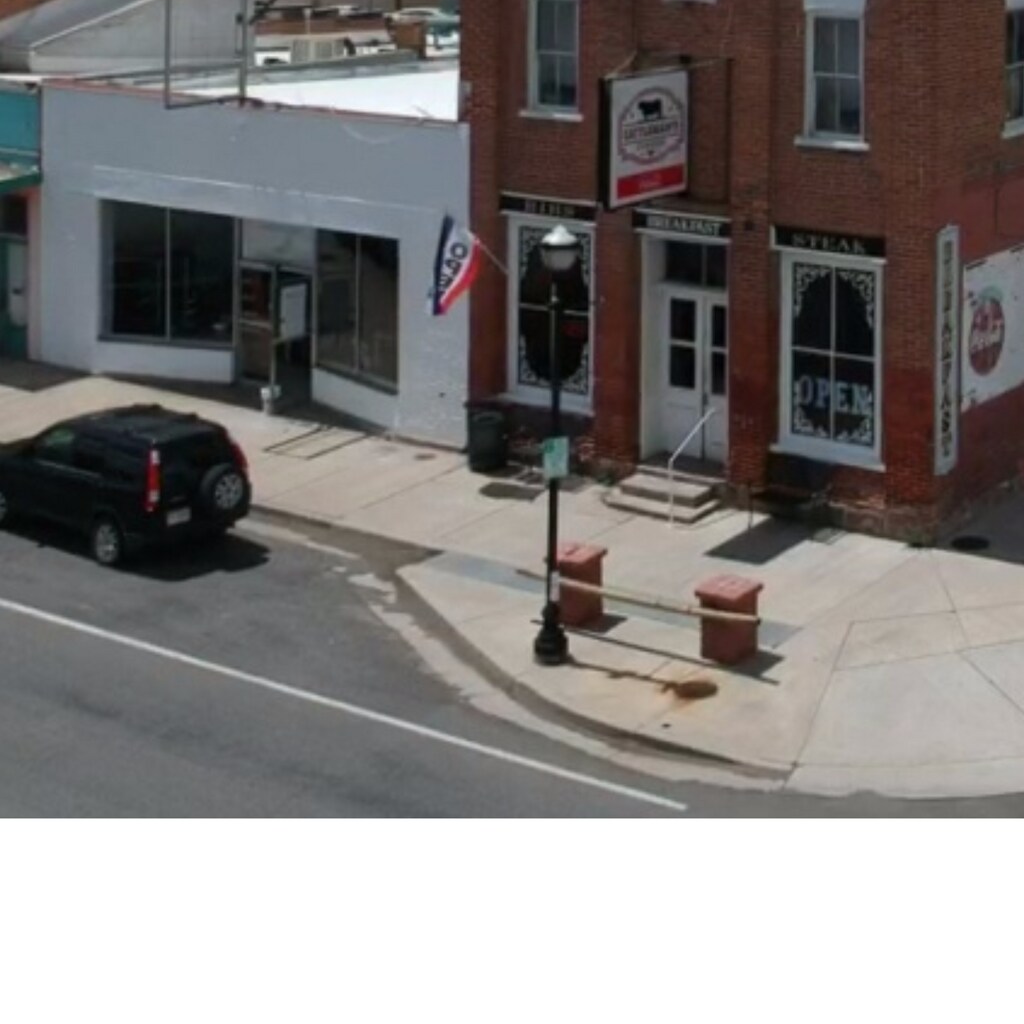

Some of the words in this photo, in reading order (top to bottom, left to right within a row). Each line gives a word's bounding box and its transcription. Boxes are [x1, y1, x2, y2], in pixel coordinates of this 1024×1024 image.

[646, 215, 721, 236] BREAKFAST
[792, 234, 865, 254] STEAK
[799, 375, 873, 415] OPEN
